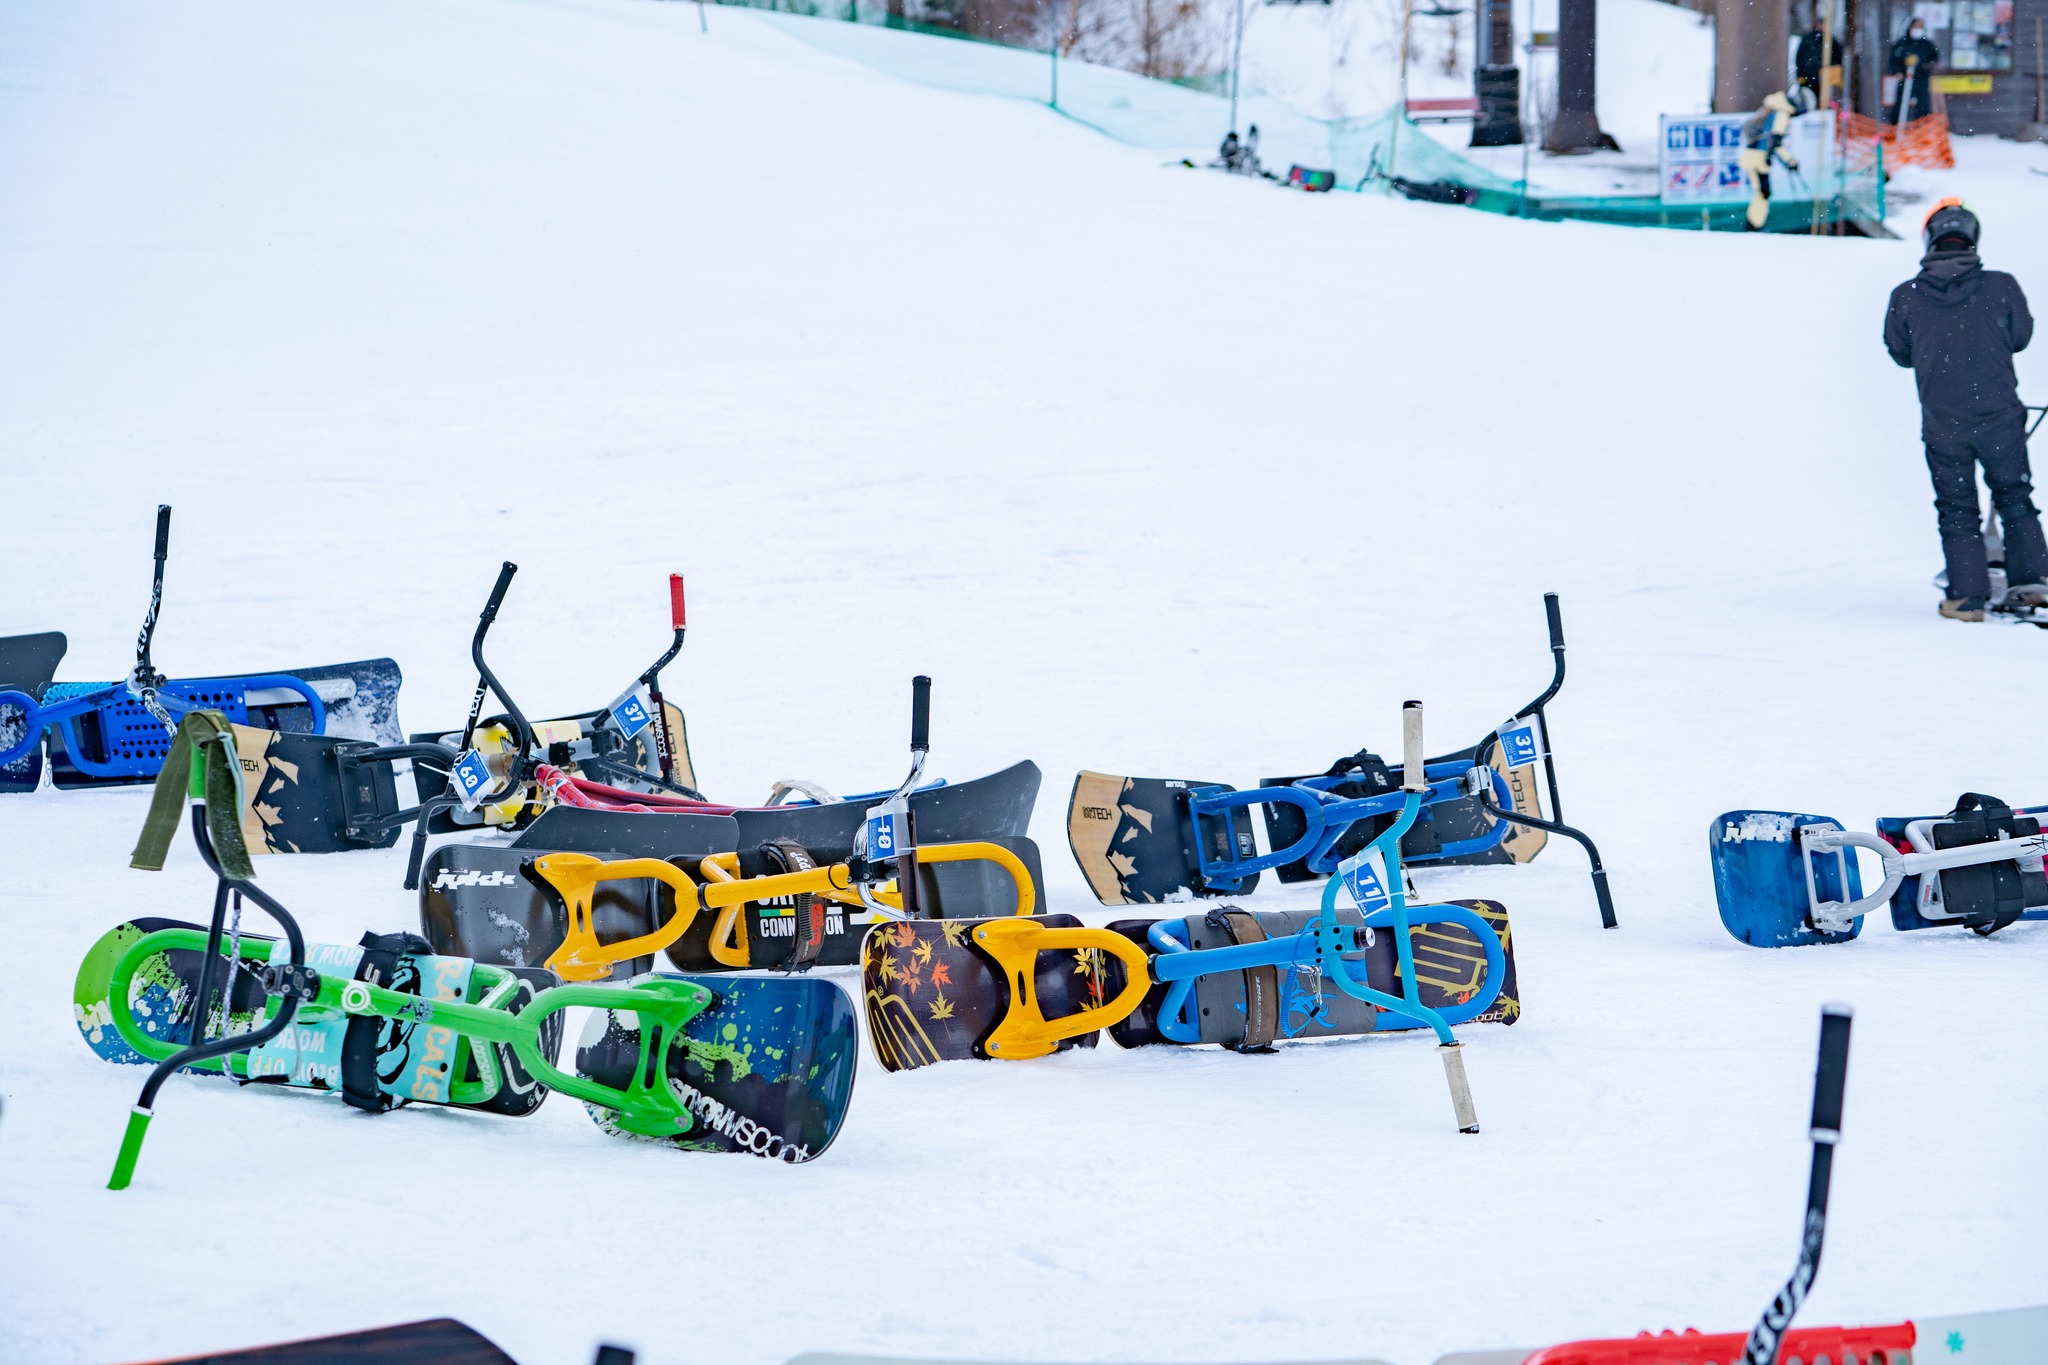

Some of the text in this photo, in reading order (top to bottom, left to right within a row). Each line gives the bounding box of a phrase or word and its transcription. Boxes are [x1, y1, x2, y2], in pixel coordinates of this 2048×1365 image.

[626, 702, 646, 721] 37
[1516, 735, 1533, 755] 31
[878, 826, 892, 848] 10
[1358, 876, 1383, 897] 11
[411, 959, 464, 1101] RACALS
